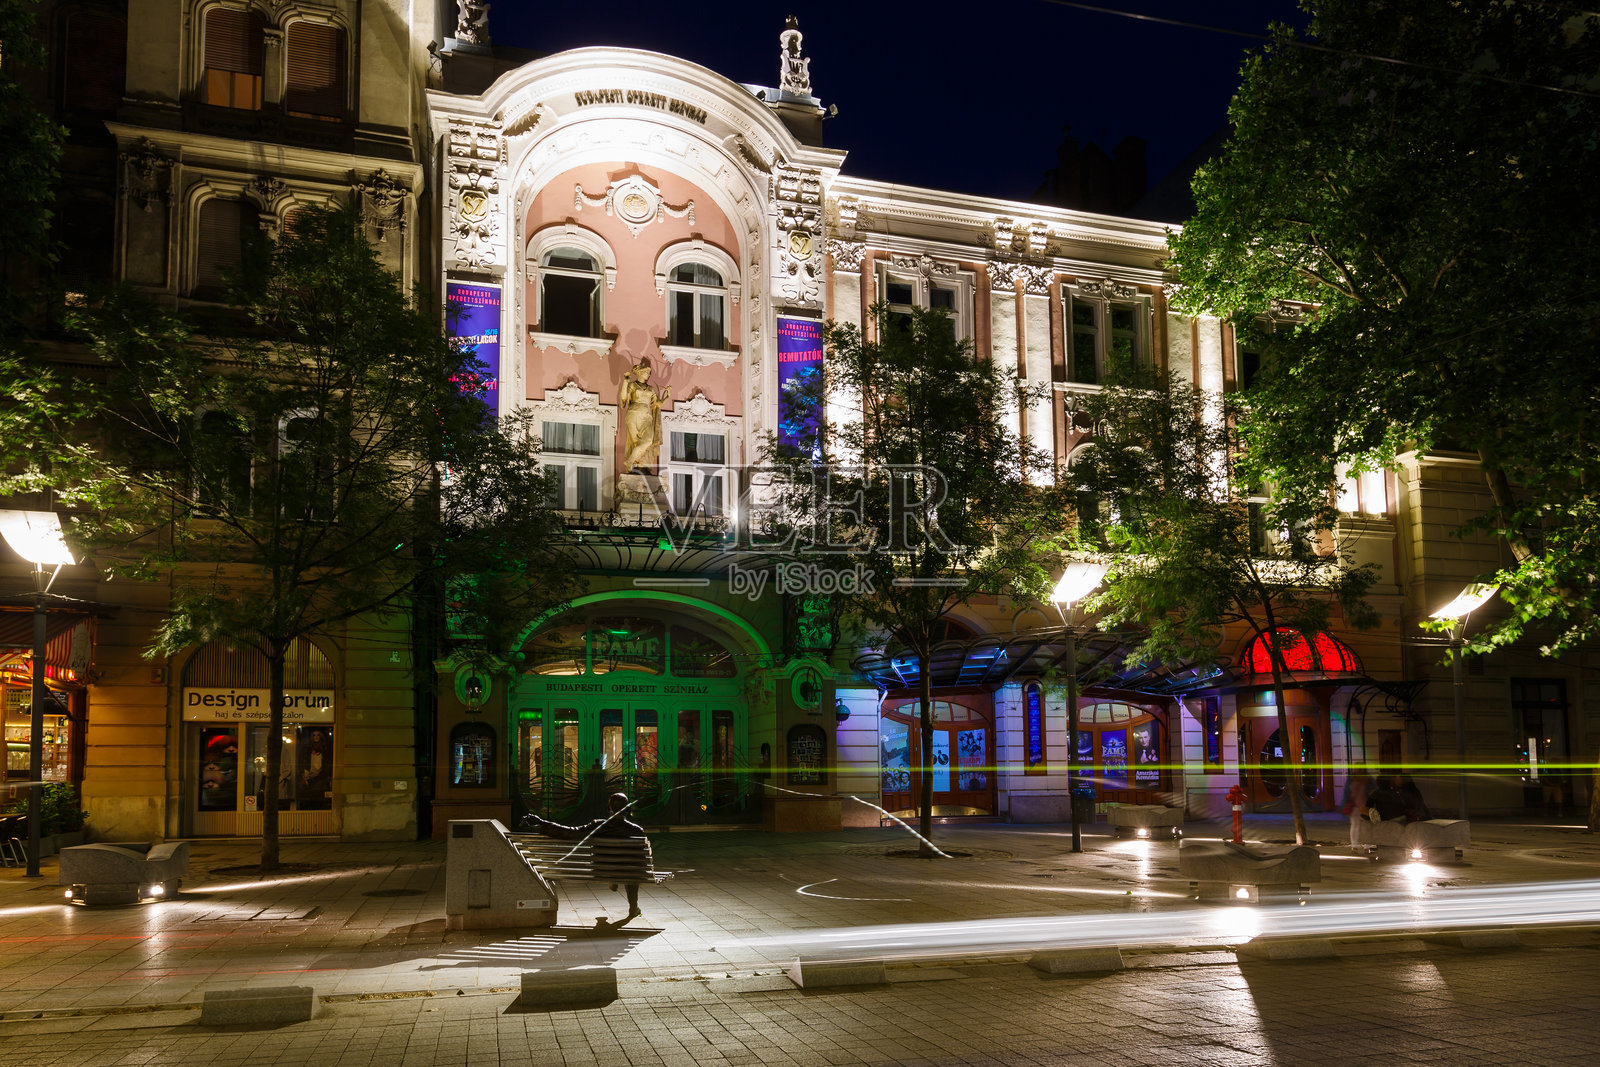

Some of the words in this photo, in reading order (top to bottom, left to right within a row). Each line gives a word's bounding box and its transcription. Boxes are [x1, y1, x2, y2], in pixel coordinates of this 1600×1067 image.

[458, 288, 491, 297] BUDAPESTI
[786, 323, 815, 331] BUDAPESTI
[778, 329, 822, 339] OPERETTSZÍNHÁ
[778, 349, 822, 362] BEMUTATÓK
[546, 683, 603, 693] BUDAPESTI
[611, 684, 657, 693] OPERETT
[188, 690, 259, 710] Design
[282, 695, 329, 708] orum
[214, 710, 228, 719] haj
[1101, 745, 1127, 758] FAME
